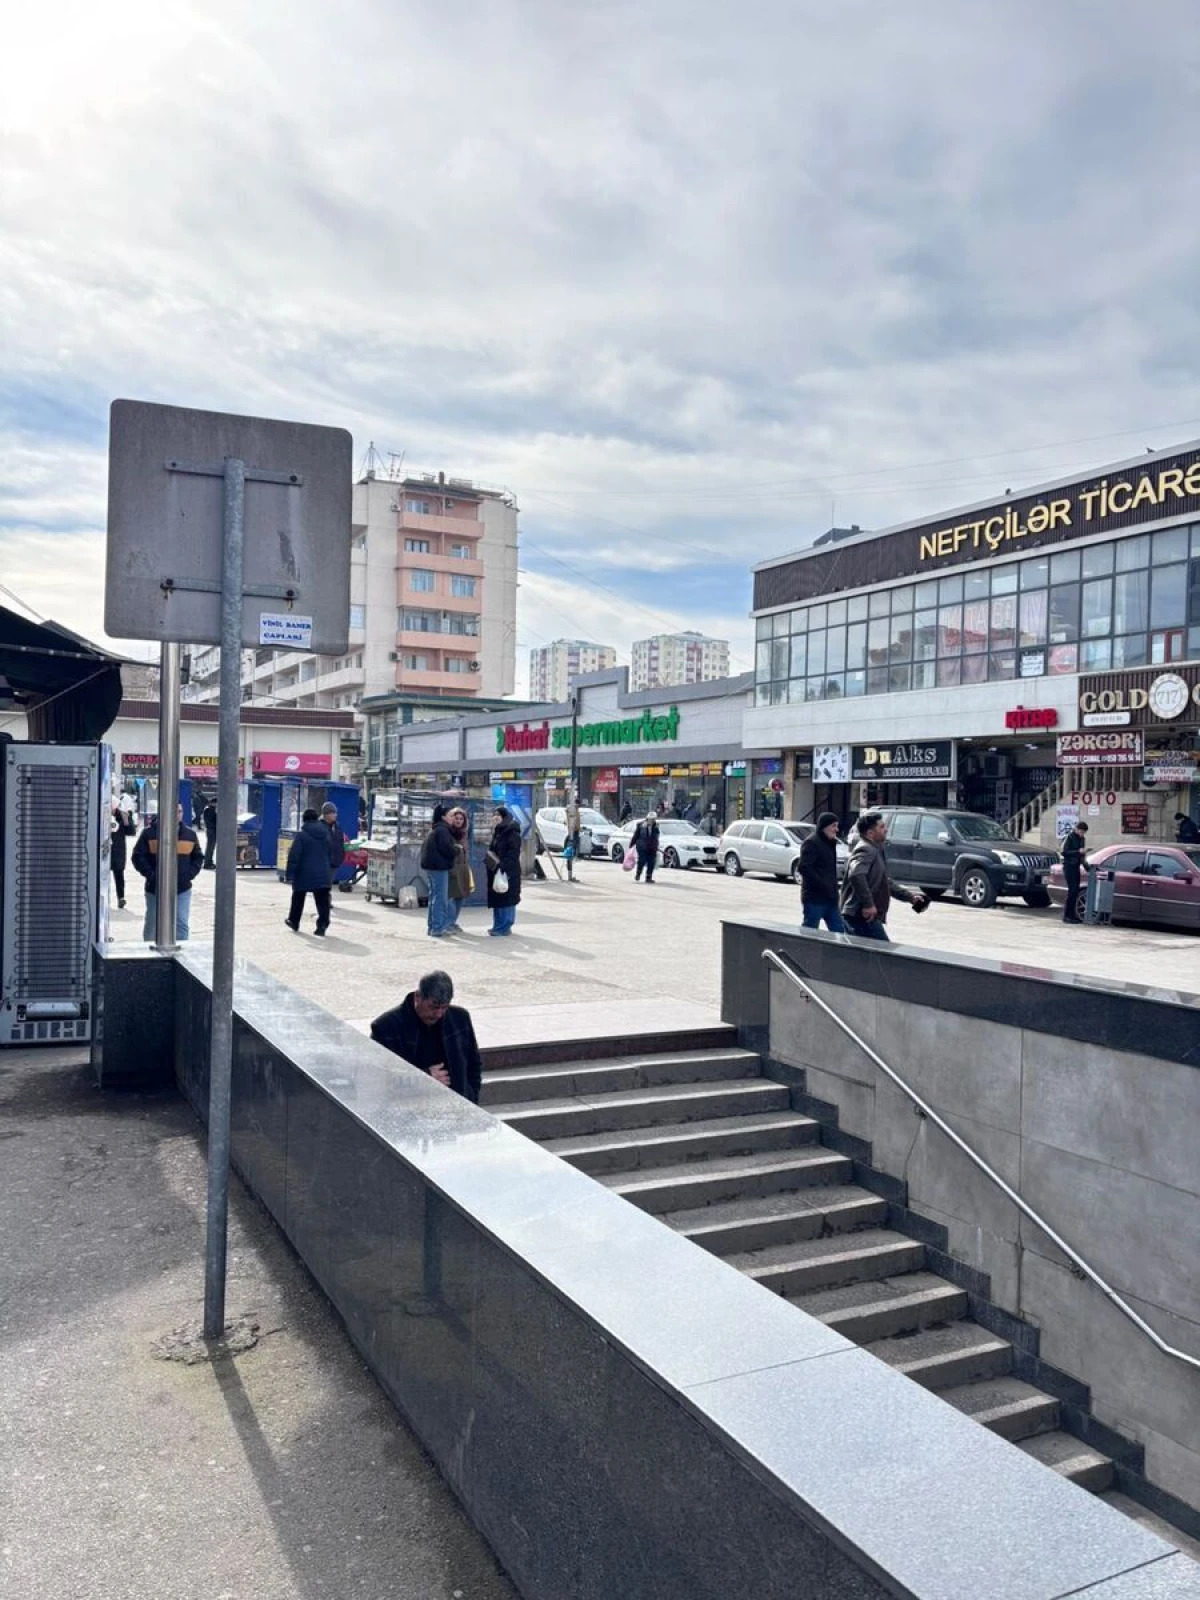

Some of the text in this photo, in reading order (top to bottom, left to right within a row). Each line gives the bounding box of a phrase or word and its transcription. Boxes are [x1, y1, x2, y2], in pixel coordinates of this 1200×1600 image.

[919, 499, 1072, 561] NEFTÇİLƏR
[1080, 688, 1148, 713] GOLD
[504, 705, 679, 752] Rahat supermarket
[1005, 705, 1058, 729] KİTAB
[1061, 732, 1136, 751] ZƏRGƏR
[122, 755, 160, 764] LOMBA
[1071, 791, 1116, 805] FOTO
